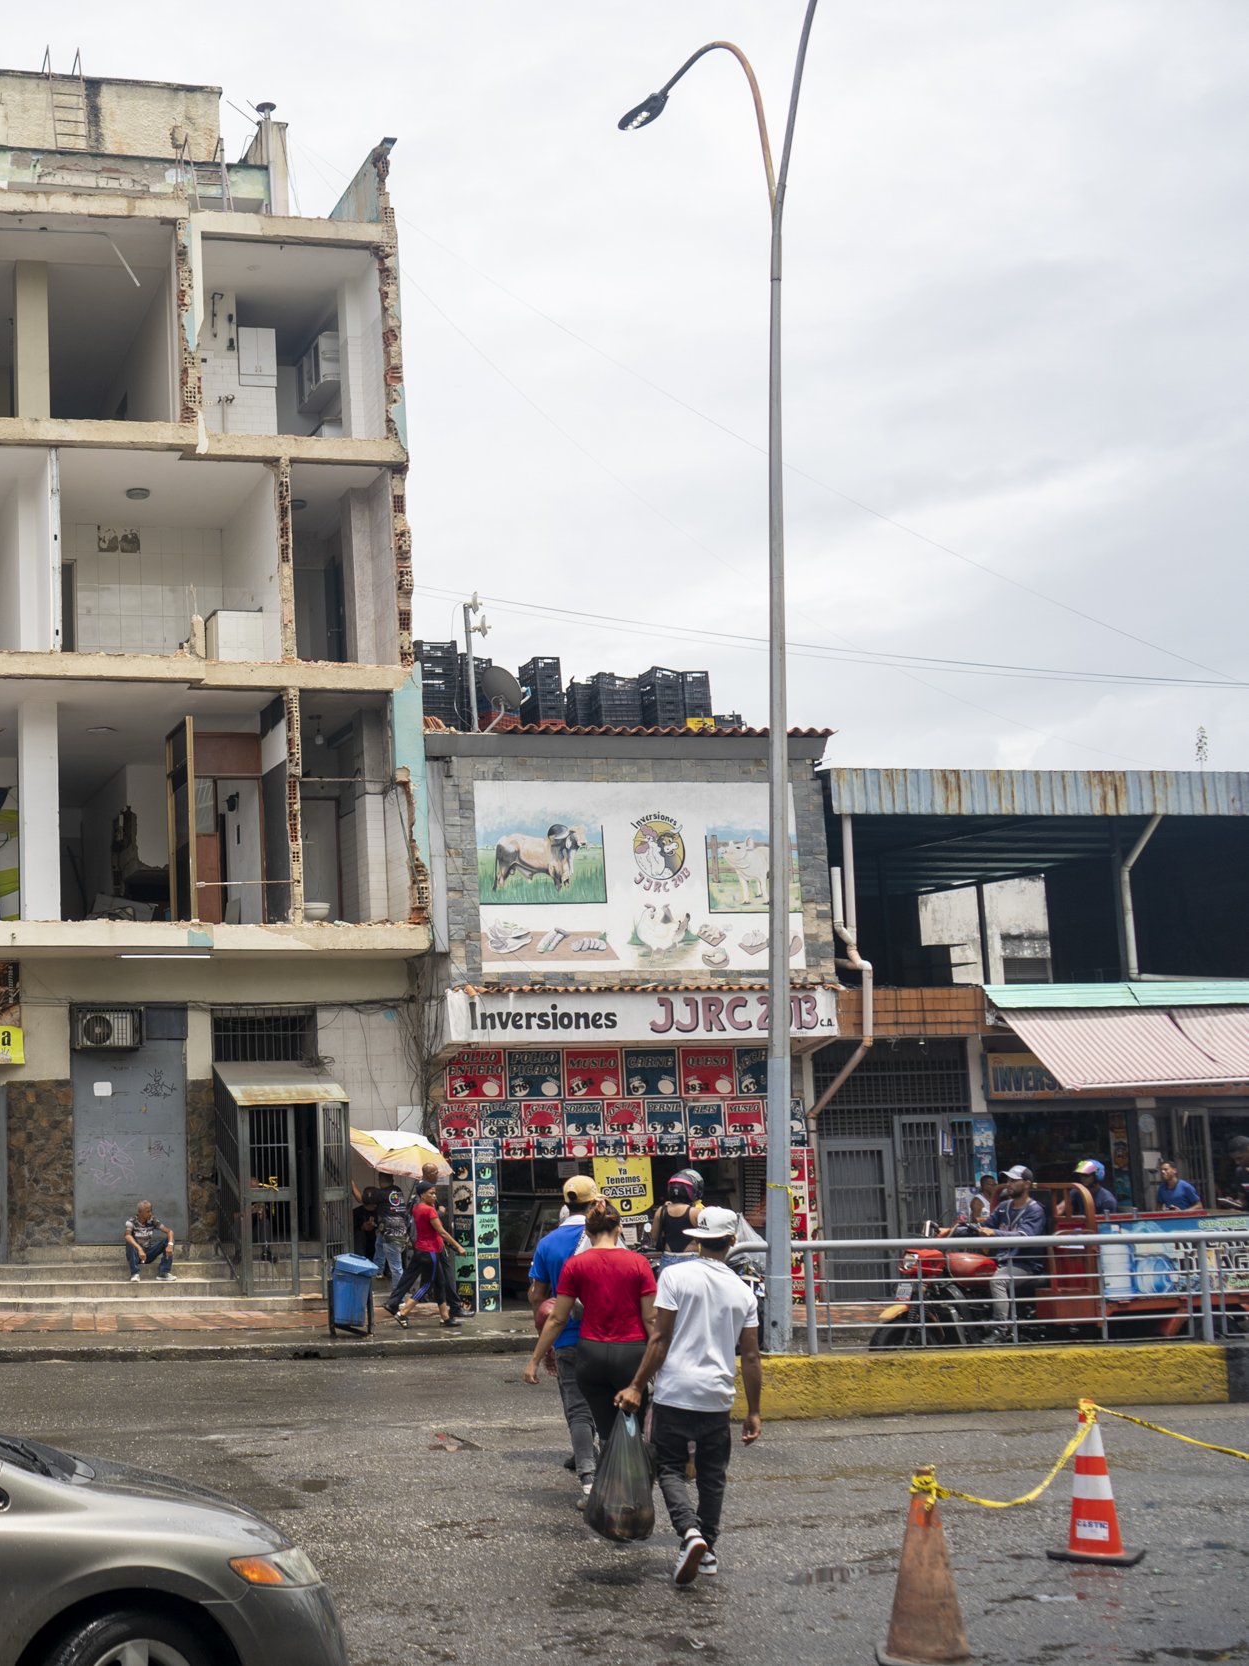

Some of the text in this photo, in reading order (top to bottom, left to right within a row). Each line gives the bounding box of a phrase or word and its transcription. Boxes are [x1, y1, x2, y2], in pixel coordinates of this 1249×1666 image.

[630, 811, 678, 829] Inversiones
[634, 867, 691, 893] JJRC 2013
[469, 1002, 618, 1030] Inversiones
[650, 996, 753, 1033] JJRC
[756, 994, 819, 1031] 213
[452, 1052, 558, 1064] POLLO POLLO
[568, 1057, 618, 1069] MUSLO
[626, 1056, 675, 1069] CARNE
[686, 1056, 730, 1068] QUESO
[447, 1064, 561, 1076] ENTERO PICADO
[439, 1103, 479, 1120] CHULETA
[479, 1102, 521, 1119] CHULETA
[604, 1102, 644, 1124] COSTILLA
[648, 1103, 681, 1112] PERNIL
[729, 1104, 760, 1113] MUSLO
[522, 1103, 562, 1126] LAGARTO
[618, 1167, 628, 1175] Ya
[605, 1175, 641, 1184] Tenemos
[602, 1185, 646, 1197] CASHEA
